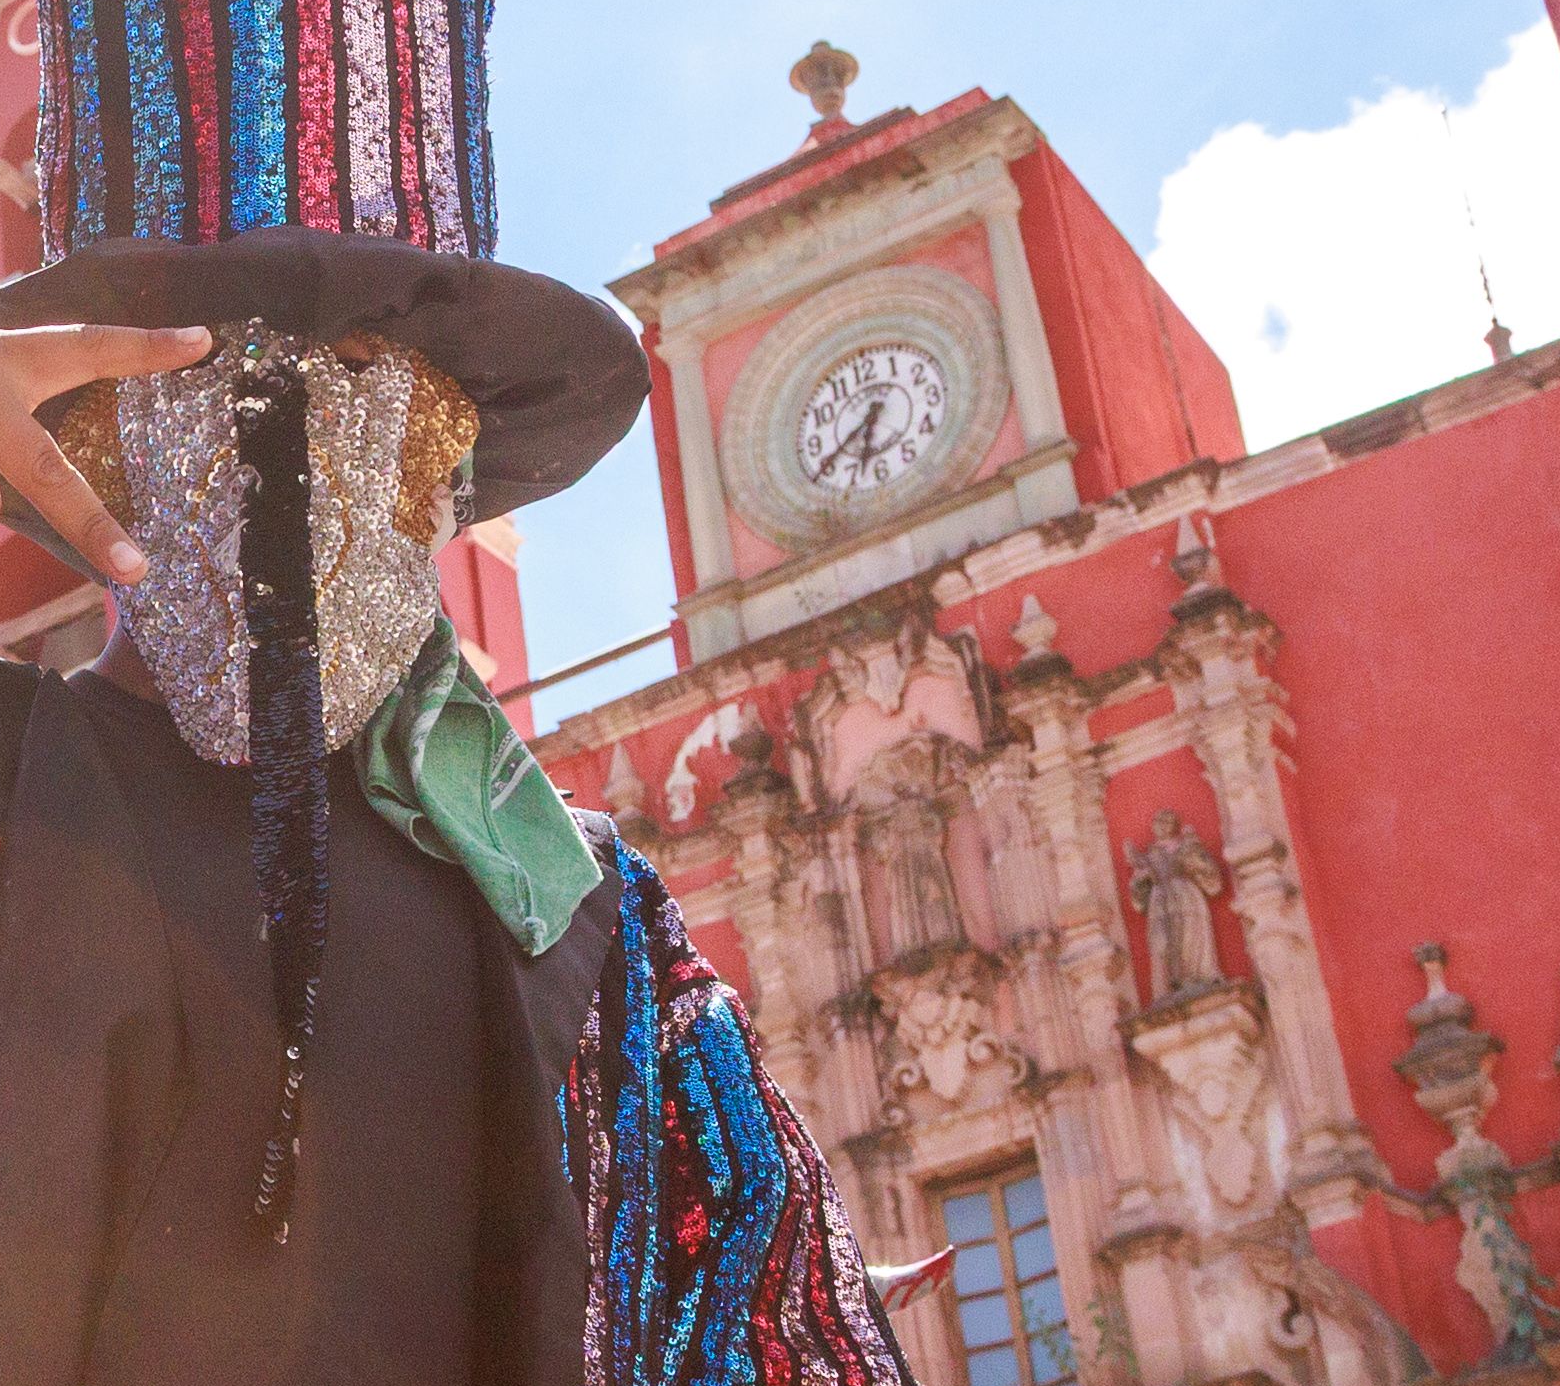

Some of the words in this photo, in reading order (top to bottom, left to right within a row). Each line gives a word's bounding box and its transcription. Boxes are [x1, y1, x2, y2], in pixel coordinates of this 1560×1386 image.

[853, 359, 877, 386] 12
[889, 356, 897, 377] 1
[911, 362, 927, 386] 2
[832, 377, 848, 401] 11
[925, 384, 941, 406] 3
[813, 402, 834, 428] 10
[919, 413, 935, 435] 4
[807, 435, 822, 457] 9
[901, 439, 916, 463] 5
[844, 463, 858, 486] 7
[874, 459, 889, 482] 6
